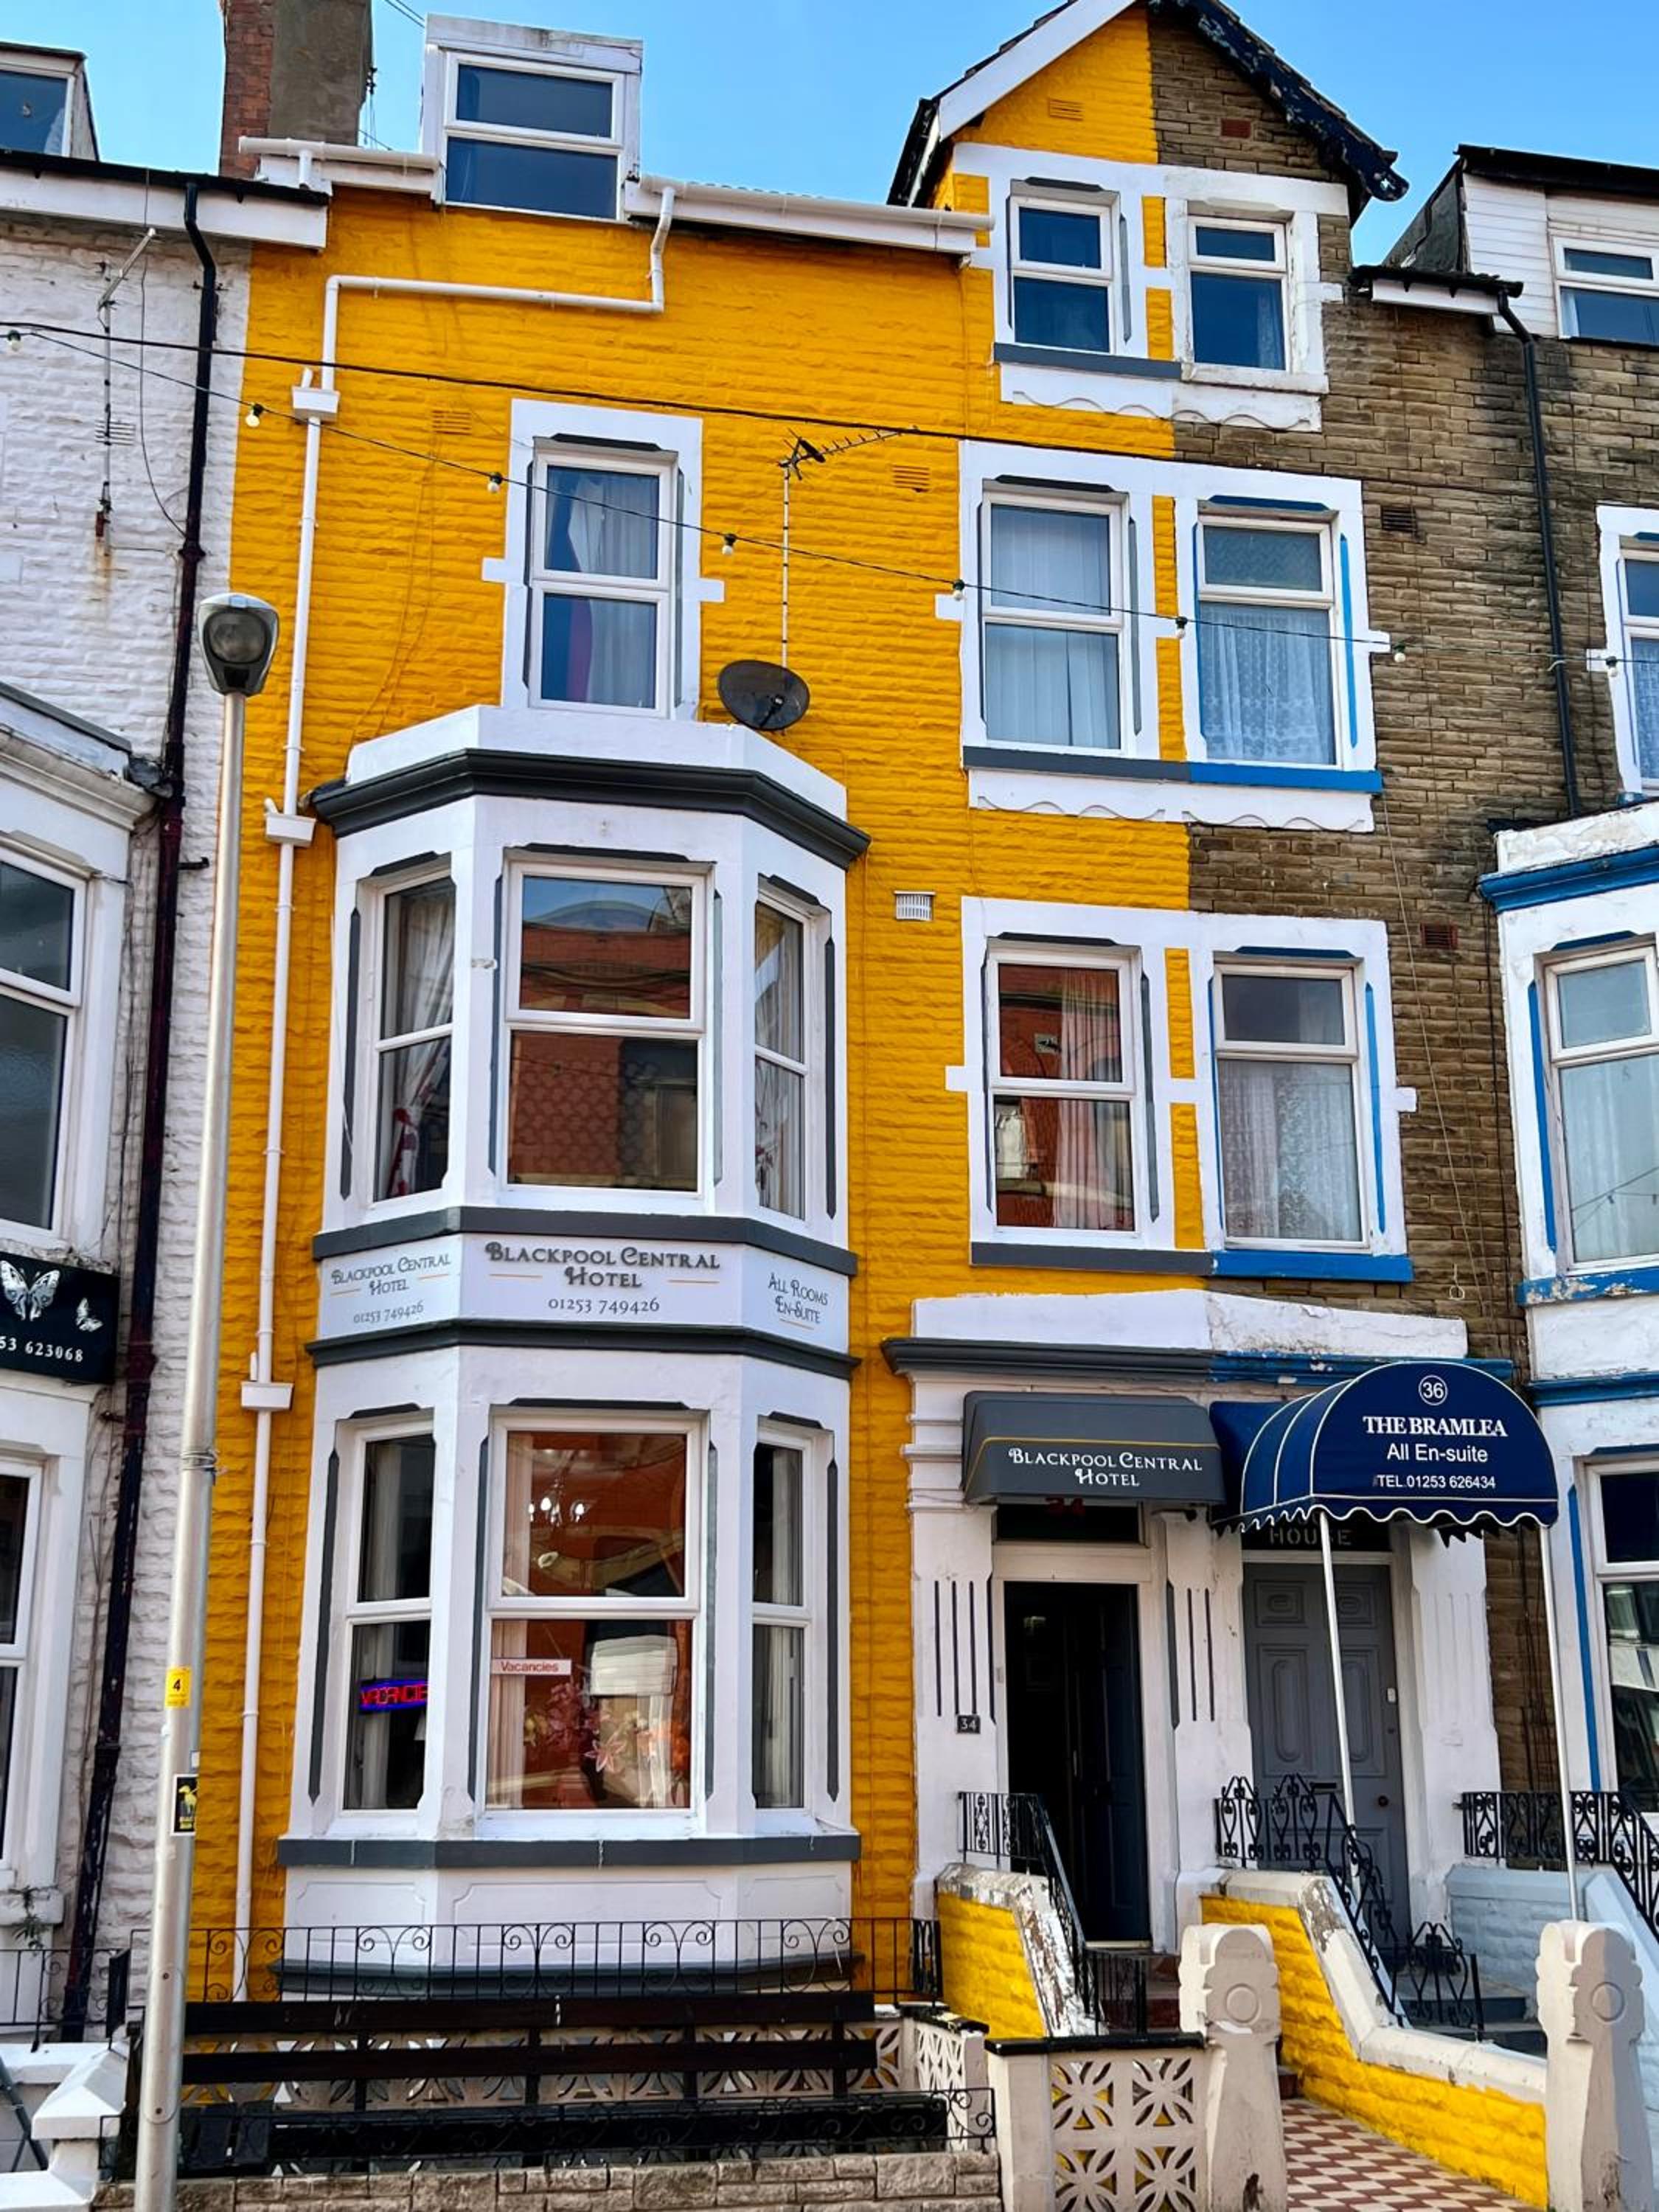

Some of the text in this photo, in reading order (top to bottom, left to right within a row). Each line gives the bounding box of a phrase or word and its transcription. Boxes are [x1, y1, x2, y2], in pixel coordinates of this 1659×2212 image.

[484, 1242, 720, 1270] BLACKPOOL CENTRAL
[331, 1253, 452, 1284] BLACKPOOL CENTRAL
[564, 1266, 642, 1288] HOTEL
[369, 1279, 410, 1295] HOTEL
[768, 1272, 829, 1306] ALL ROOMS
[353, 1300, 425, 1324] 01253 749426
[548, 1297, 660, 1315] 01253 749426
[775, 1295, 821, 1324] EN-SUITE
[24, 1340, 84, 1363] 623068
[1422, 1382, 1444, 1399] 36
[1363, 1416, 1509, 1437] THE BRAMLEA
[1008, 1447, 1203, 1471] BLACKPOOL CENTRAL
[1387, 1442, 1489, 1462] All En-suite
[1074, 1468, 1140, 1486] HOTEL
[1449, 1475, 1496, 1489] 626434
[1270, 1527, 1352, 1545] HOUE
[501, 1661, 559, 1672] Vacancies
[173, 1679, 181, 1692] 4
[961, 1718, 977, 1731] 34
